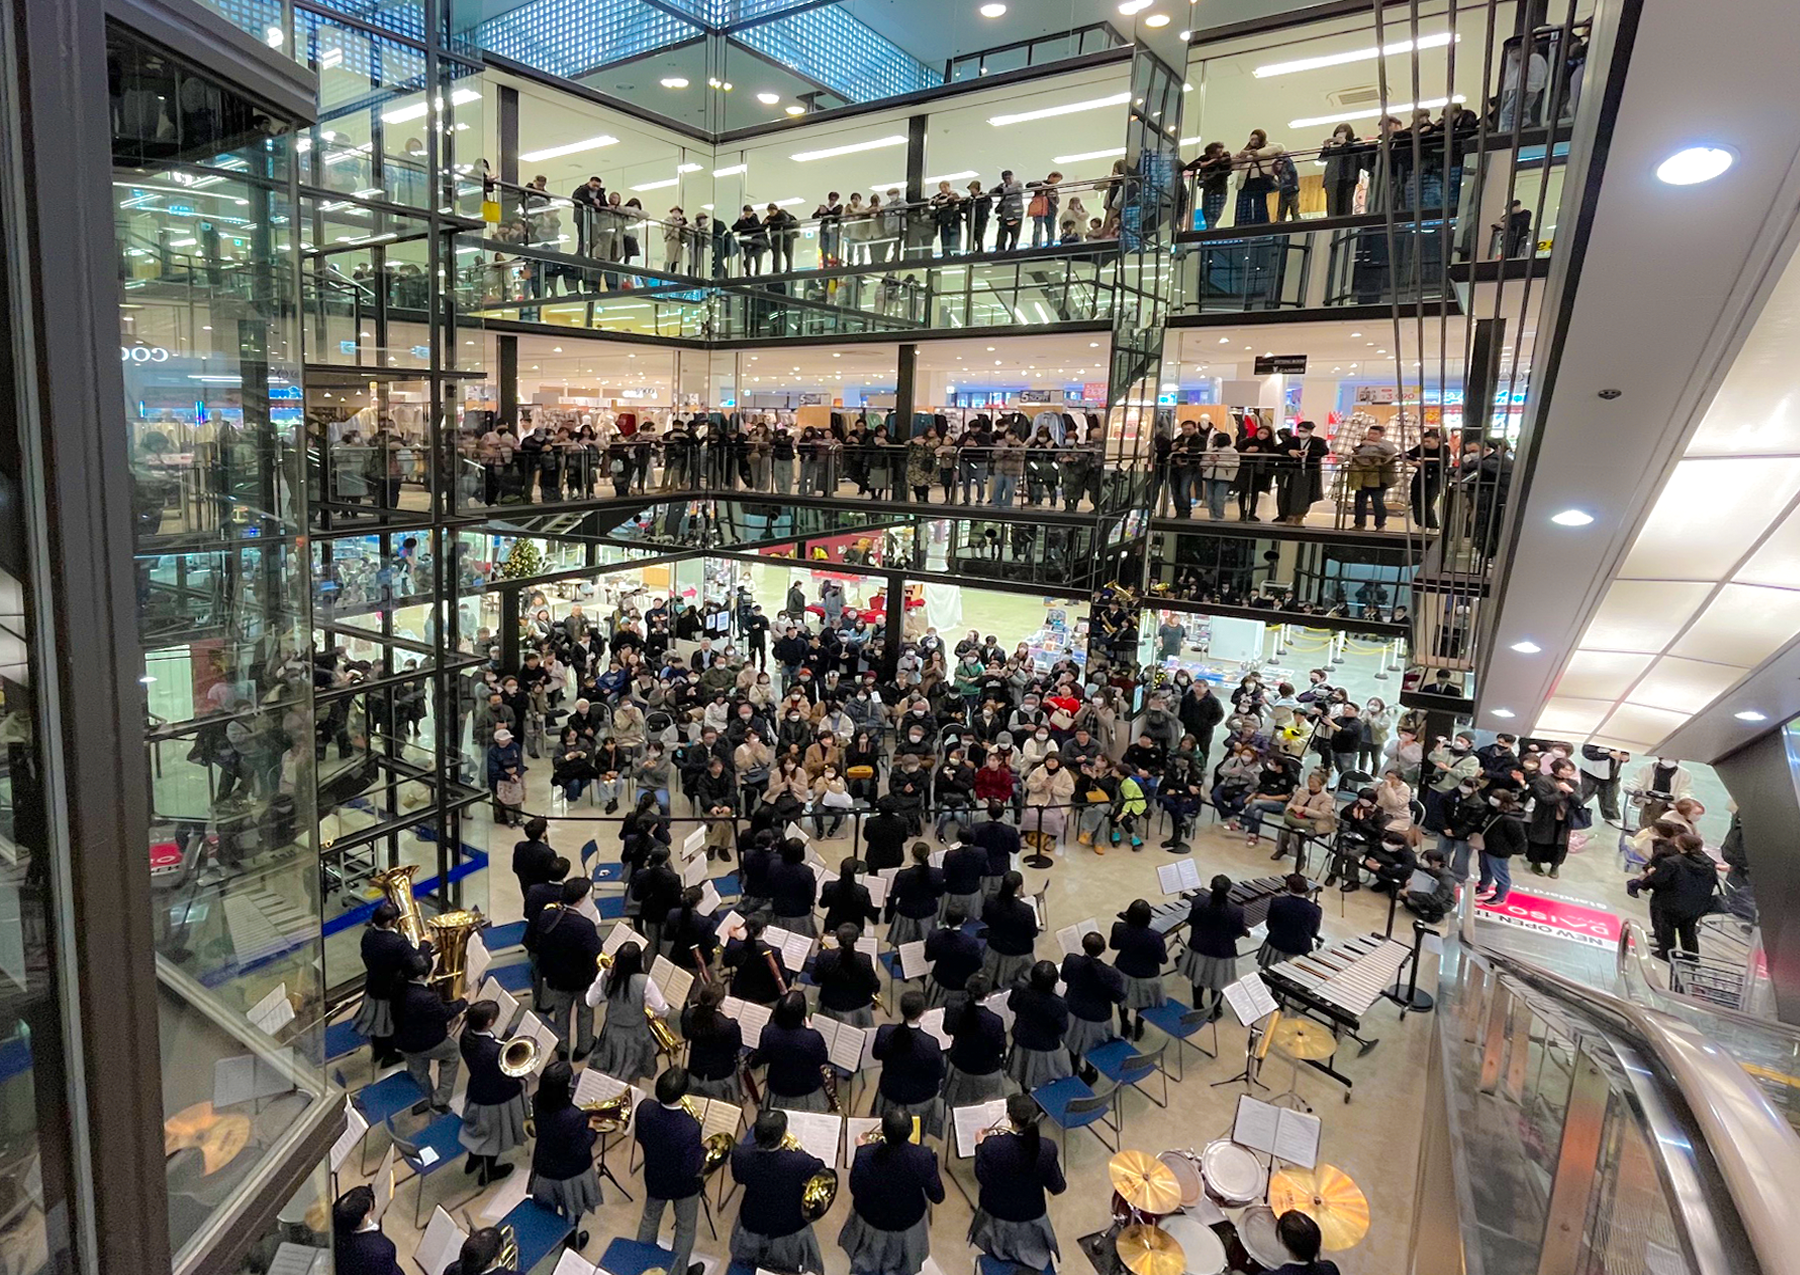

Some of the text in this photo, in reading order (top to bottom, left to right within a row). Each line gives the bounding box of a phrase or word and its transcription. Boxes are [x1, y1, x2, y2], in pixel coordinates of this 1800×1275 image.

[1534, 888, 1607, 910] Standard
[1499, 915, 1552, 934] OPEN
[1508, 906, 1609, 935] DAISO
[1556, 930, 1604, 946] NEW
